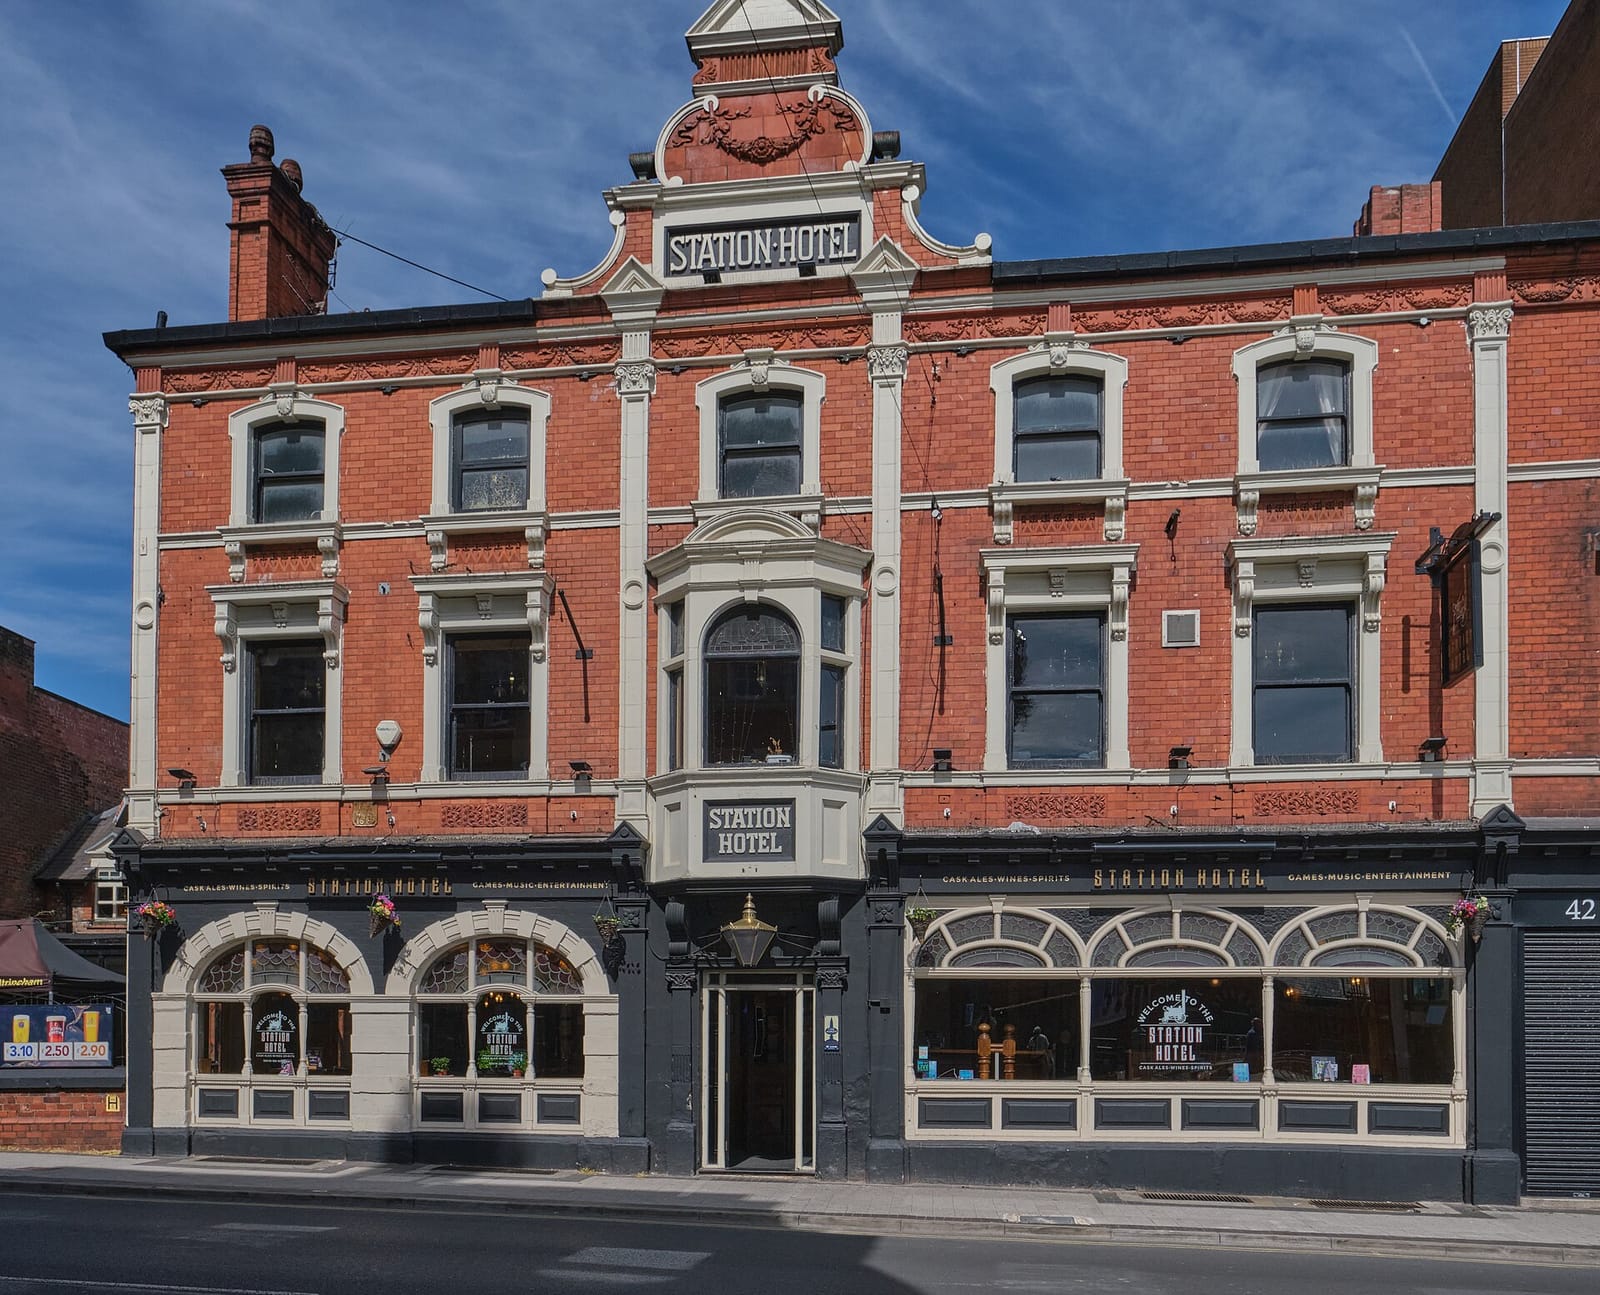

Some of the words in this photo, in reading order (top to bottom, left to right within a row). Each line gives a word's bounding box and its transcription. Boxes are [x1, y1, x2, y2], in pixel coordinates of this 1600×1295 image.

[709, 807, 791, 829] STATION
[718, 832, 782, 854] HOTEL
[307, 877, 384, 894] STATION
[395, 877, 452, 894] HOTEL
[942, 875, 968, 883] CASK
[1094, 869, 1184, 887] STATION
[1197, 868, 1264, 886] HOTEL
[1565, 899, 1596, 920] 42
[1137, 994, 1181, 1023] WELCOME
[1198, 1003, 1214, 1022] THE
[261, 1032, 290, 1042] STATION
[486, 1034, 517, 1044] STATION
[1149, 1027, 1203, 1043] STATION
[264, 1042, 287, 1053] HOTEL
[490, 1044, 513, 1055] HOTEL
[1156, 1045, 1196, 1061] HOTEL
[107, 1095, 118, 1110] H
